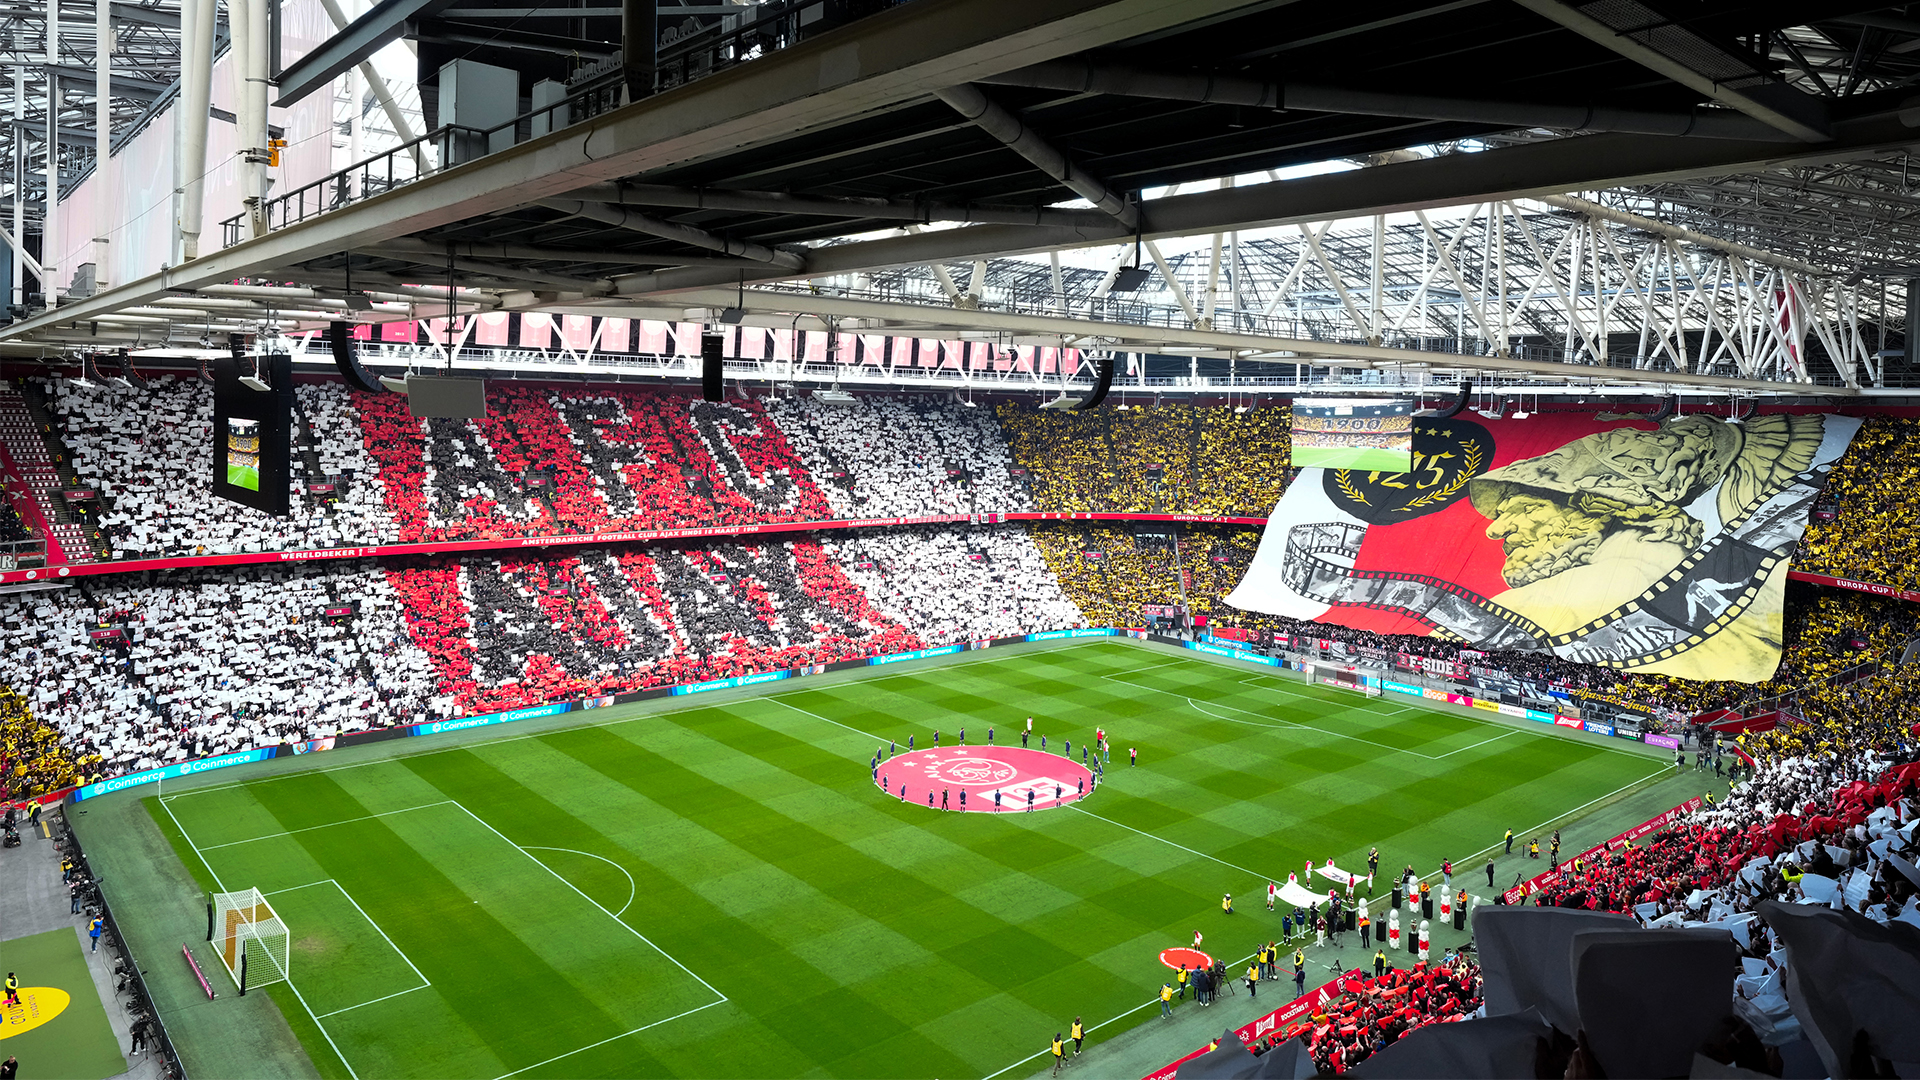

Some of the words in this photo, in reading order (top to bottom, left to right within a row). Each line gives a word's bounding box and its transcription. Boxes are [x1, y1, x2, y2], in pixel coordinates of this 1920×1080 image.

[848, 518, 897, 526] LANDSKAMPIOEN
[521, 536, 594, 546] AMSTERDAMSCHE
[280, 549, 355, 560] WERELDBEKER
[1836, 580, 1869, 591] EUROPA
[1871, 585, 1889, 594] CUP
[926, 647, 952, 656] Coinmerce
[1201, 645, 1228, 655] Coinmerce
[887, 653, 914, 662] Coinmerce
[1241, 653, 1269, 664] Coinmerce
[1409, 655, 1454, 675] F-SIDE
[745, 673, 777, 684] Coinmerce
[694, 681, 729, 692] Coinmerce
[1384, 681, 1419, 695] Coinmerce
[1572, 687, 1604, 701] Ajax
[1605, 693, 1622, 706] 125
[1624, 698, 1652, 714] Jaar
[510, 707, 552, 720] Coinmerce
[443, 717, 489, 731] Coinmerce
[1617, 728, 1641, 738] UNIBET
[1647, 736, 1675, 746] CURAÇAO
[193, 754, 250, 771] Coinmerce
[107, 770, 165, 791] Coinmerce
[1281, 1003, 1305, 1021] ROCKSTARS
